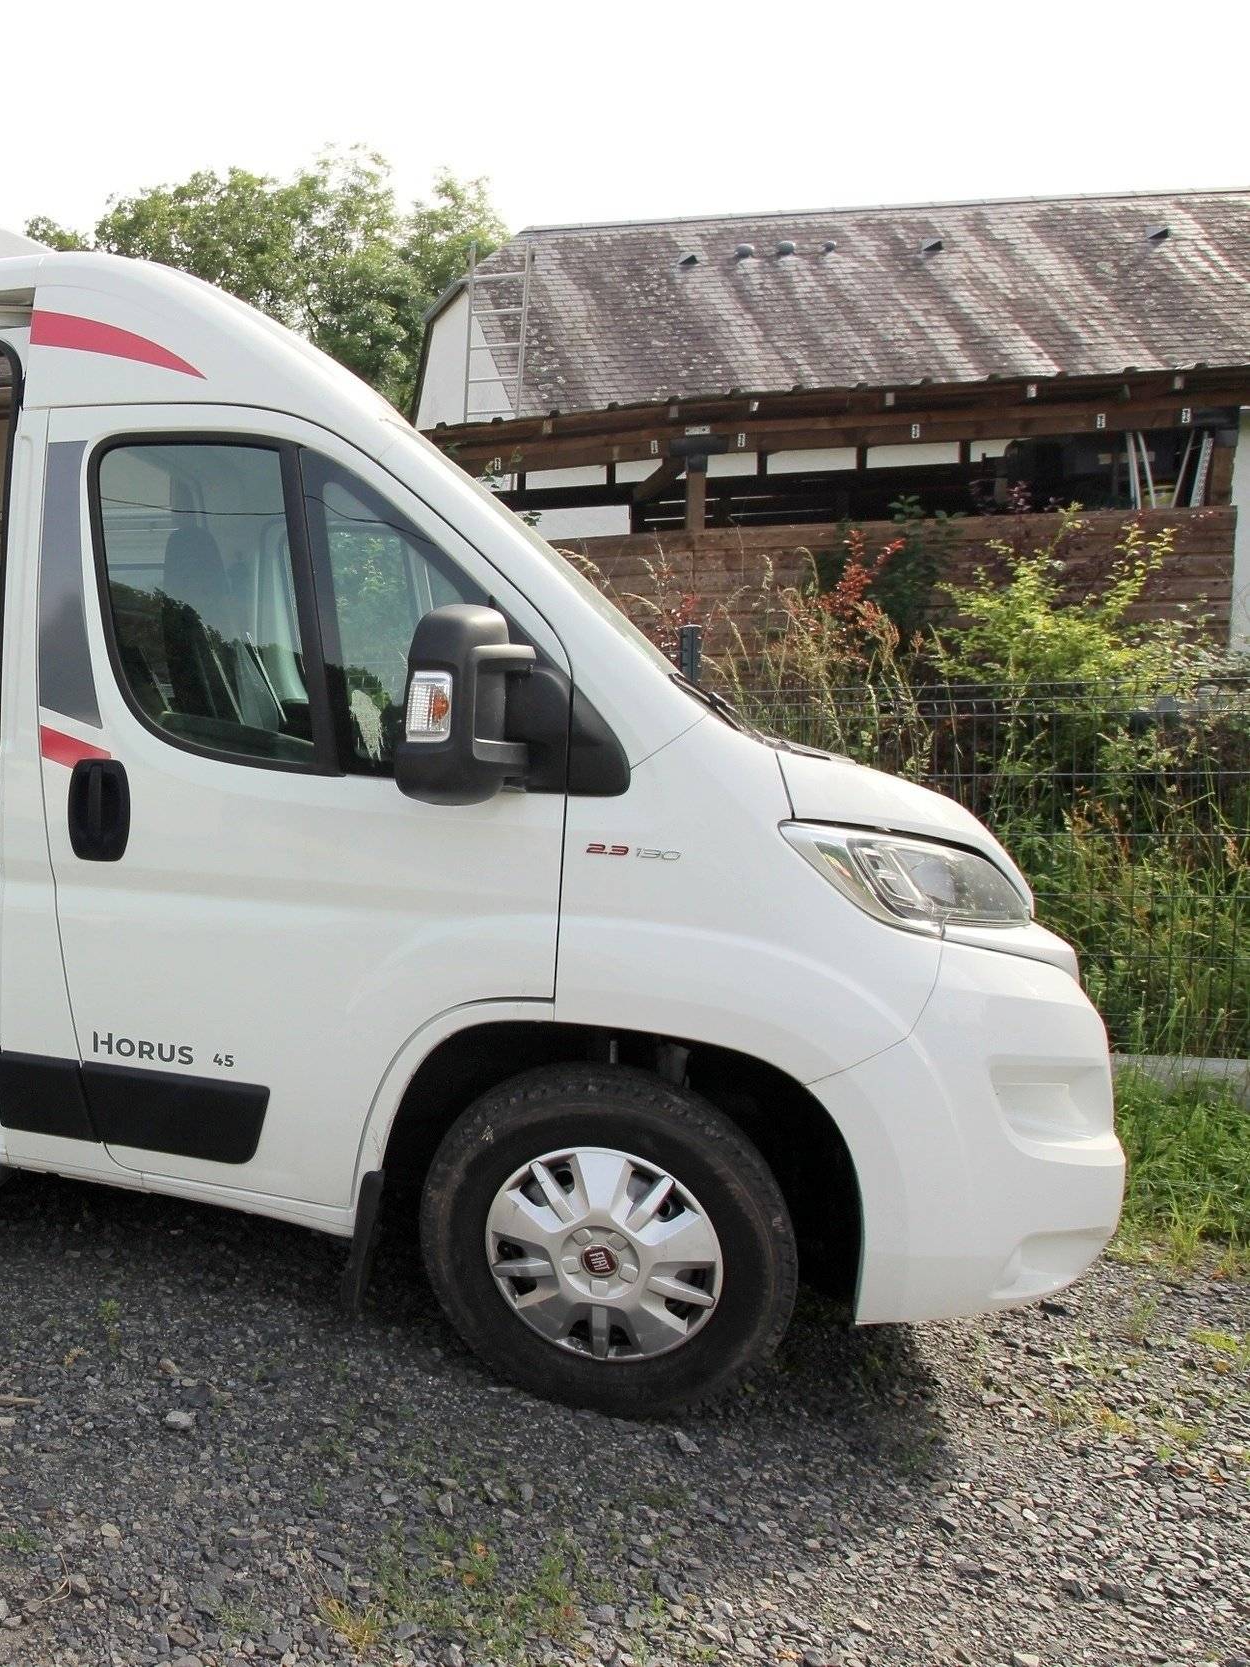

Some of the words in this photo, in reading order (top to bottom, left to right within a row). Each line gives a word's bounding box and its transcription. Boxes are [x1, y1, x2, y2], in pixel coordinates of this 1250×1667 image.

[586, 843, 629, 856] 2.3
[92, 1030, 194, 1065] HORUS
[212, 1053, 235, 1068] 45
[589, 1251, 610, 1271] FIAT
